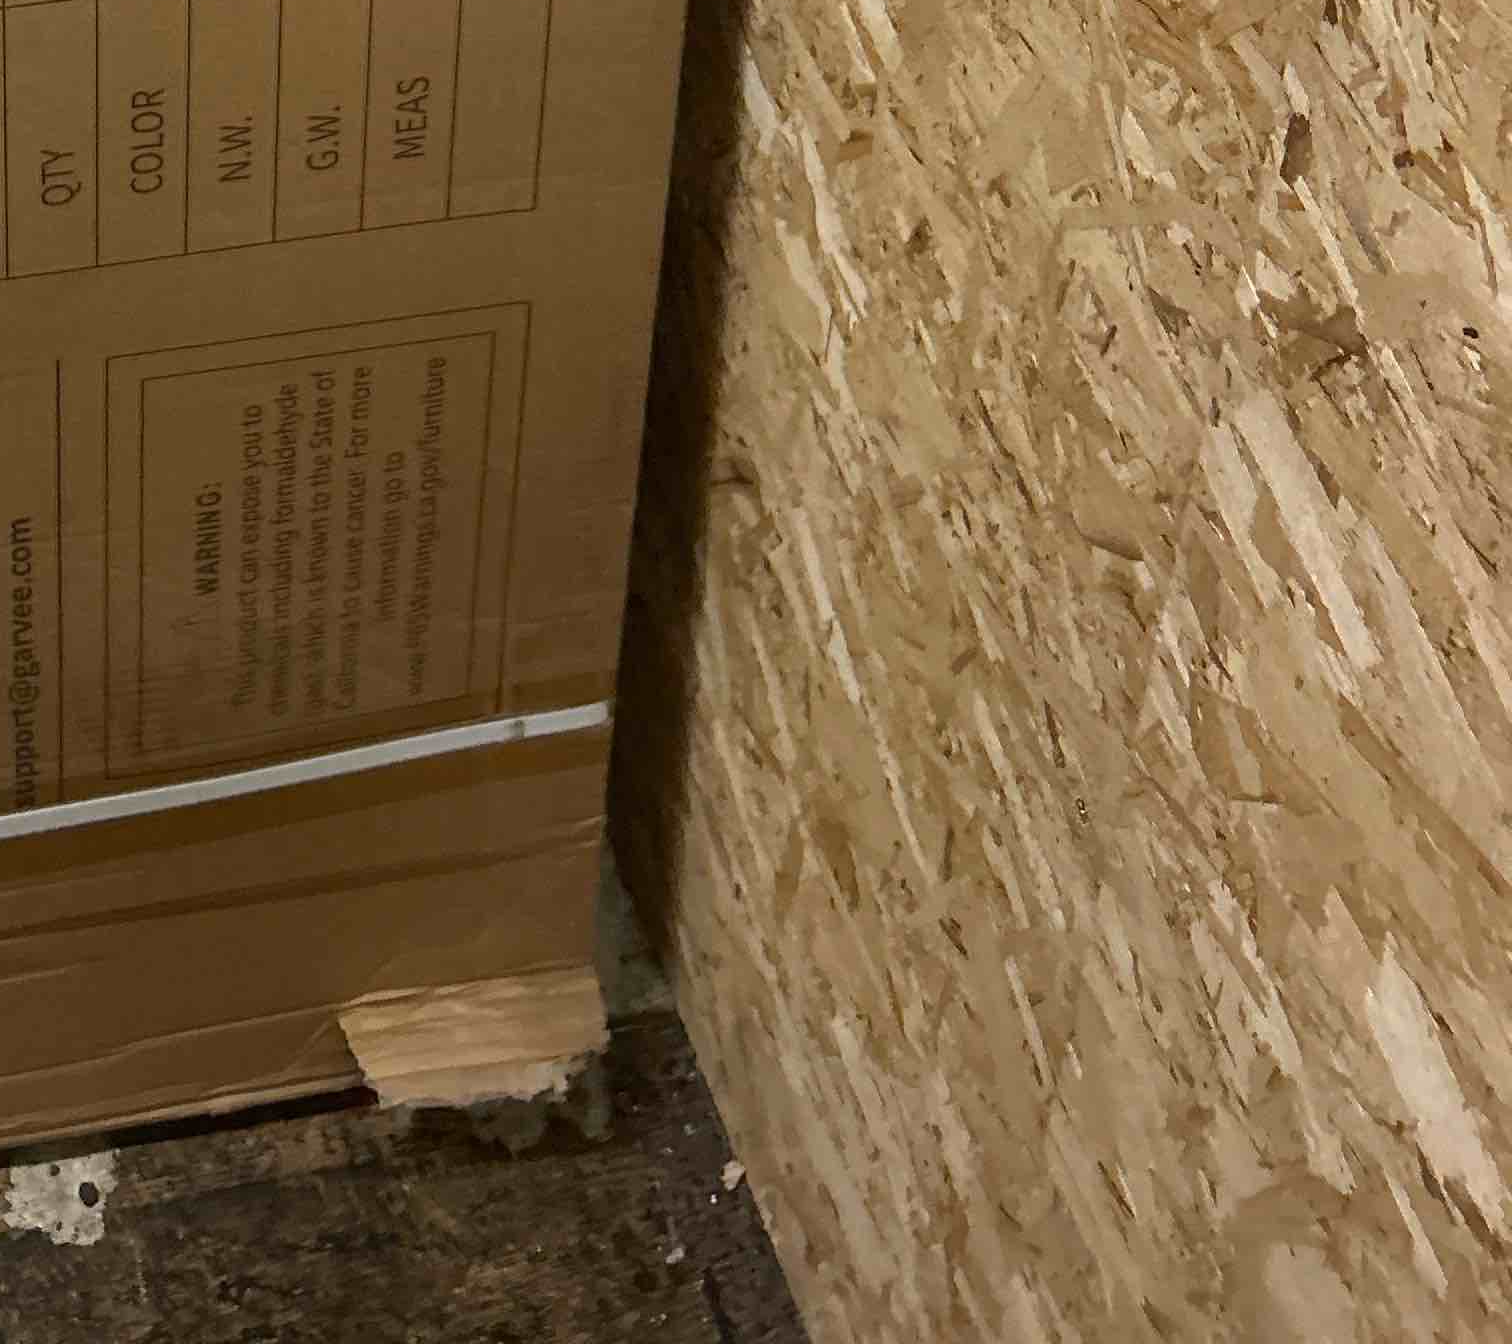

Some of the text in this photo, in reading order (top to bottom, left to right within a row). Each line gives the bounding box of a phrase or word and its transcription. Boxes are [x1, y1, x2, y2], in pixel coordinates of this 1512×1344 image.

[130, 88, 164, 194] COLOR
[306, 104, 341, 170] G.W.
[392, 75, 430, 161] MEAS
[41, 149, 81, 206] QTY
[219, 115, 253, 183] N.W.
[311, 368, 336, 392] of
[349, 367, 372, 421] more
[241, 404, 263, 426] to
[310, 396, 335, 448] State
[344, 427, 368, 460] For
[242, 432, 268, 469] you
[271, 383, 304, 525] formaldehyde
[308, 454, 332, 488] the
[240, 475, 266, 544] expose
[311, 490, 332, 513] to
[193, 480, 223, 596] WARNING:
[308, 516, 330, 584] known
[377, 451, 408, 621] information go to
[239, 550, 260, 584] can
[269, 529, 299, 619] including
